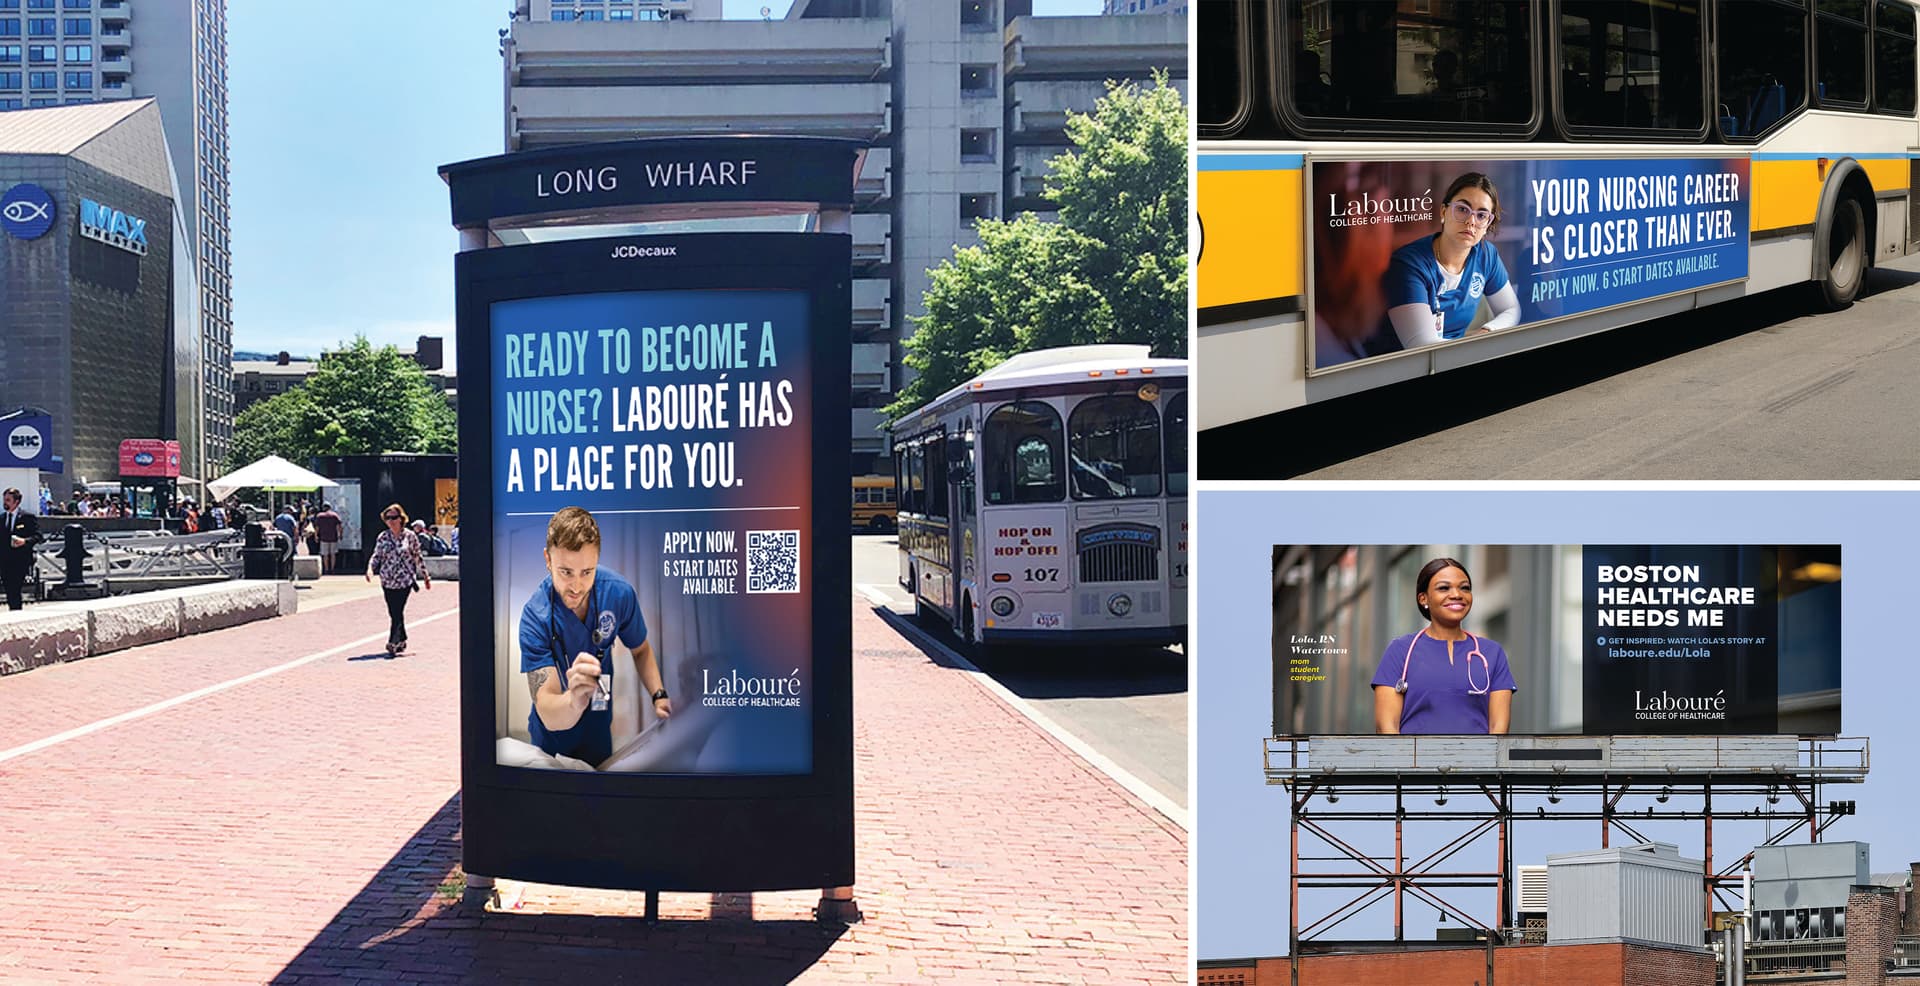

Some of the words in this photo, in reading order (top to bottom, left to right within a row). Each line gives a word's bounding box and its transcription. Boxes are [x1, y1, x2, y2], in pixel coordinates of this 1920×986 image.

[537, 166, 617, 197] LONG
[645, 160, 757, 188] WHARF
[1329, 189, 1433, 217] Labouré
[1532, 178, 1590, 217] YOUR
[1598, 175, 1677, 212] NURSING
[1684, 173, 1739, 206] CAREER
[80, 198, 148, 246] IMAX
[1330, 217, 1367, 227] COLLEGE
[1370, 216, 1382, 224] OF
[1383, 213, 1433, 224] HEALTHCARE
[1532, 226, 1554, 265] IS
[1564, 218, 1638, 261] CLOSER
[1645, 213, 1690, 249] THAN
[1697, 210, 1736, 243] EVER.
[611, 245, 676, 259] JCDecaux
[1531, 278, 1568, 303] APPLY
[1572, 273, 1599, 295] NOW.
[1603, 272, 1609, 289] 6
[1612, 266, 1643, 288] START
[1646, 260, 1673, 281] DATES
[1676, 253, 1720, 276] AVAILABLE.
[505, 330, 588, 378] READY
[598, 327, 630, 375] TO
[642, 322, 748, 372] BECOME
[758, 321, 777, 368] A
[506, 388, 602, 436] NURSE?
[612, 373, 729, 432] LABOURÉ
[739, 379, 793, 428] HAS
[11, 435, 39, 447] BHC
[506, 447, 524, 493] A
[534, 445, 614, 491] PLACE
[625, 443, 673, 490] FOR
[683, 441, 744, 488] YOU.
[999, 528, 1028, 537] HOP
[1032, 527, 1052, 537] ON
[664, 531, 702, 553] APPLY
[706, 530, 738, 553] NOW.
[1020, 538, 1030, 546] &
[994, 546, 1023, 556] HOP
[1027, 546, 1058, 555] OFF!
[664, 560, 670, 577] 6
[673, 559, 704, 577] START
[708, 559, 738, 577] DATES
[1024, 568, 1059, 582] 107
[1598, 565, 1699, 583] BOSTON
[683, 578, 738, 594] AVAILABLE.
[1598, 587, 1755, 605] HEALTHCARE
[1598, 609, 1680, 627] NEEDS
[1687, 609, 1723, 627] ME
[1319, 634, 1337, 644] RN
[1608, 637, 1625, 645] GET
[1626, 637, 1666, 645] INSPIRED:
[1667, 637, 1696, 645] WATCH
[1727, 637, 1753, 645] STORY
[1755, 637, 1766, 645] AT
[1290, 645, 1348, 655] Watertown
[1608, 647, 1711, 659] laboure.edu/Lola
[703, 667, 800, 695] Labouré
[702, 697, 737, 707] COLLEGE
[738, 697, 749, 707] OF
[751, 697, 800, 707] HEALTHCARE
[1635, 689, 1726, 711] Labouré
[1635, 712, 1667, 720] COLLEGE
[1668, 712, 1678, 720] OF
[1679, 712, 1726, 720] HEALTHCARE
